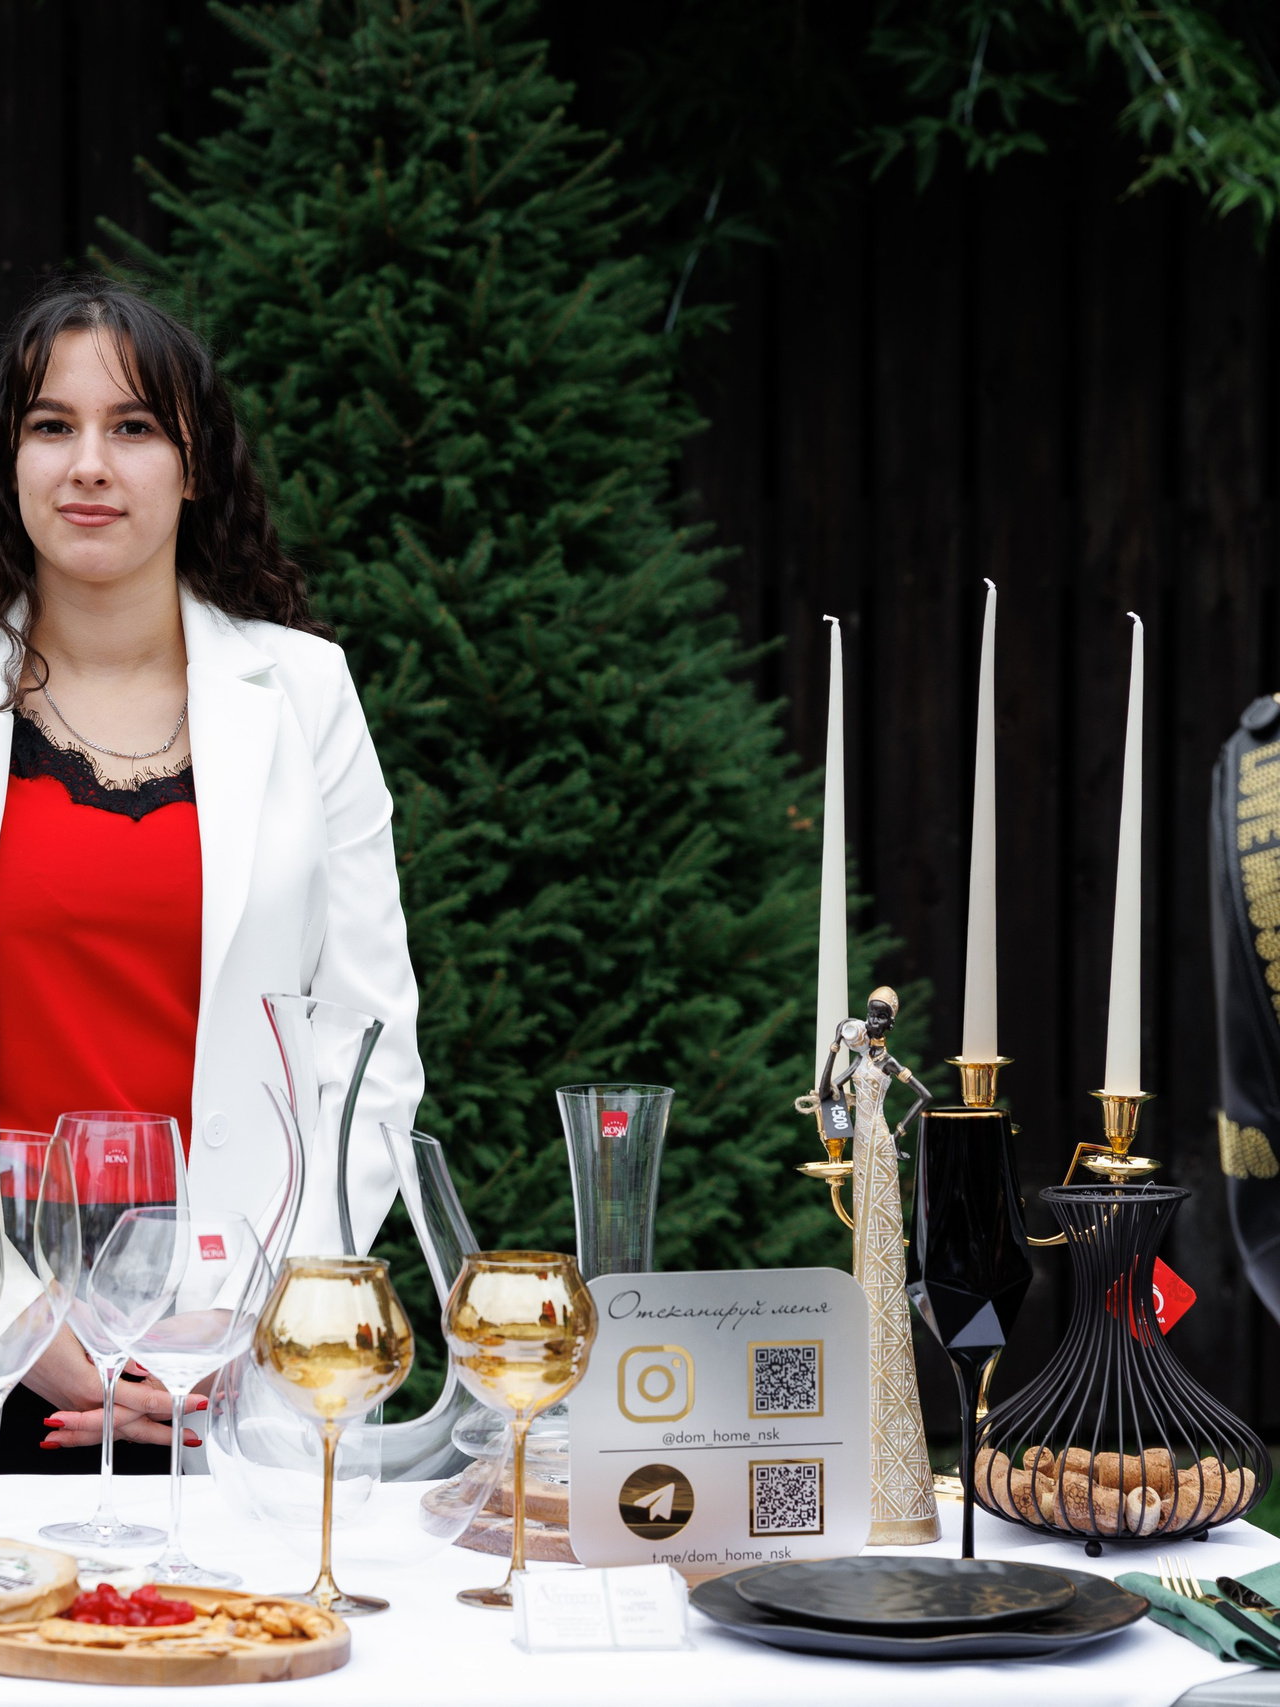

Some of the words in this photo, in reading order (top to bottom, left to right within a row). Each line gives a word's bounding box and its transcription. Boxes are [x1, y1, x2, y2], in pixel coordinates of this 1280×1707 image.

[830, 1104, 849, 1130] 1500
[608, 1290, 767, 1331] Отсканируй
[771, 1301, 833, 1315] меня
[662, 1427, 780, 1446] @dom_home_nsk
[652, 1546, 792, 1566] t.me/dom_home_nsk
